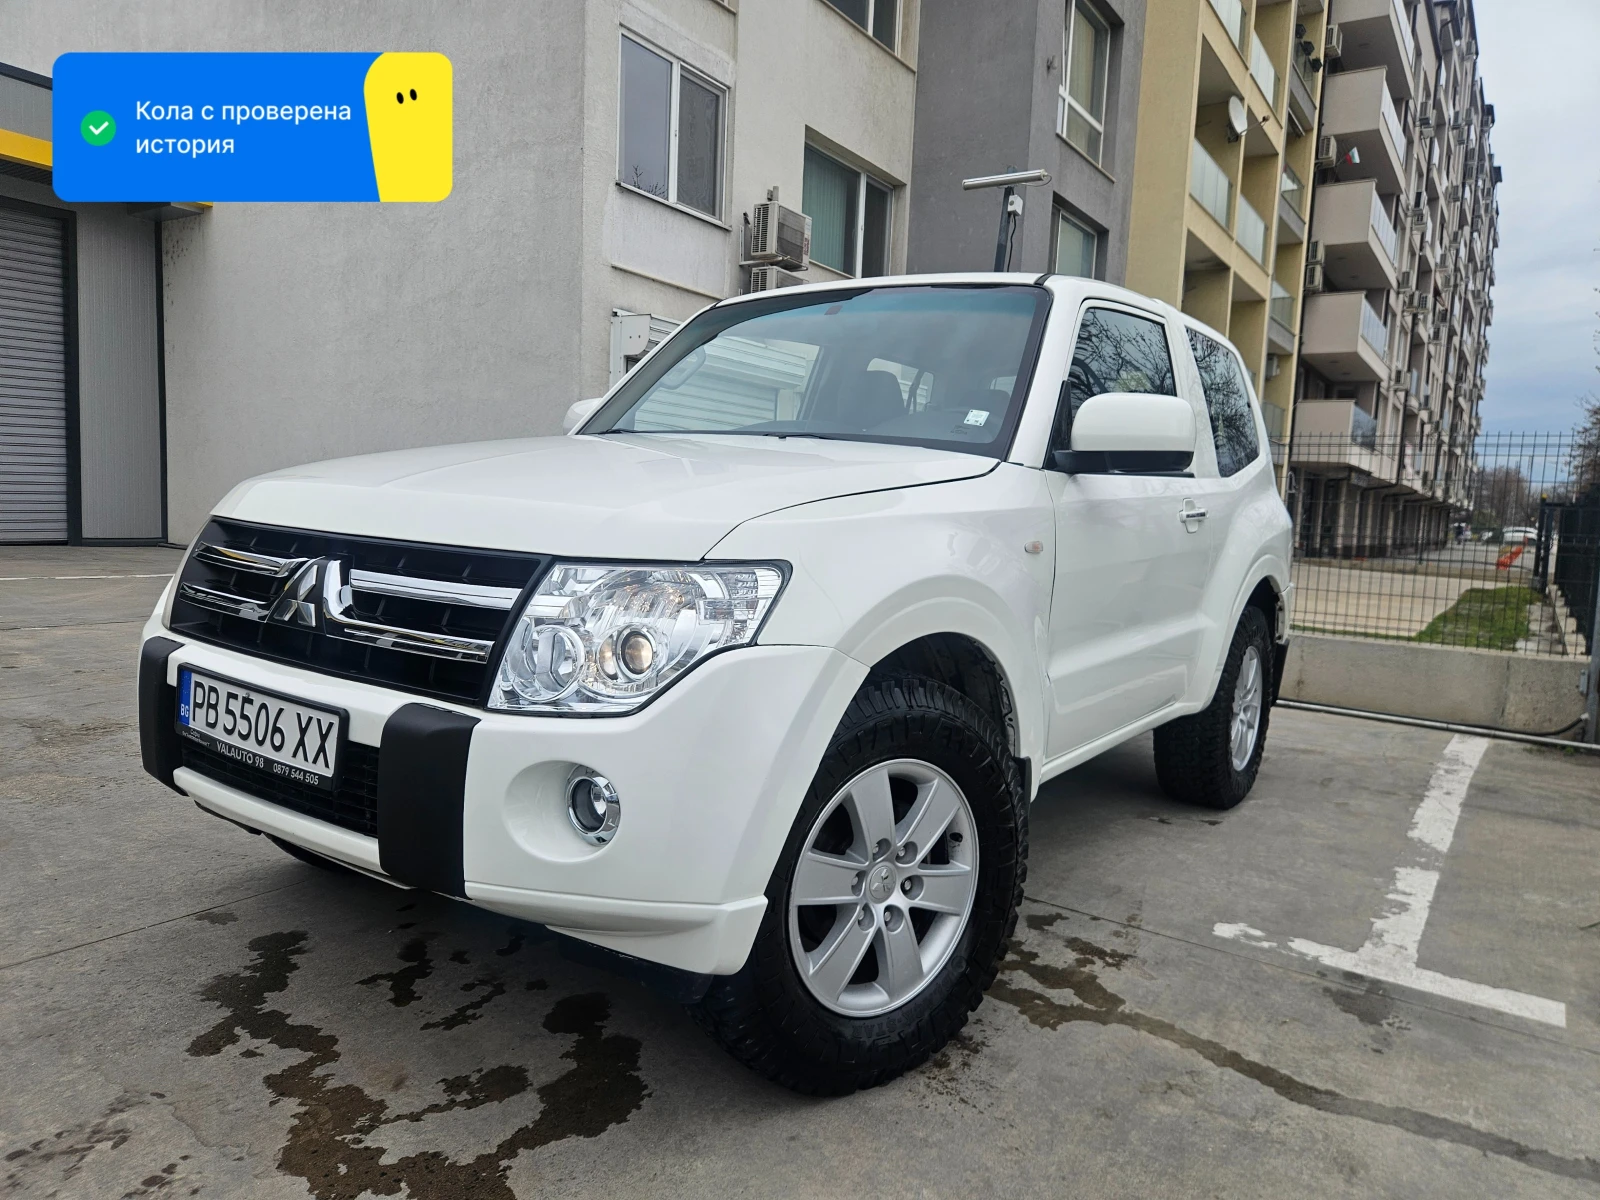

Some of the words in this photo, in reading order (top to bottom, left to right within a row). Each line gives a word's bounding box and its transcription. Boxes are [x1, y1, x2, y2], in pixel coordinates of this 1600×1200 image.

[180, 703, 189, 717] BG
[192, 680, 219, 729] PB
[223, 691, 285, 752] 5506
[291, 711, 335, 769] XX
[216, 741, 254, 764] VALAUTO
[254, 756, 264, 768] 98
[272, 762, 290, 776] 0879
[290, 770, 304, 781] 544
[305, 774, 319, 786] 505
